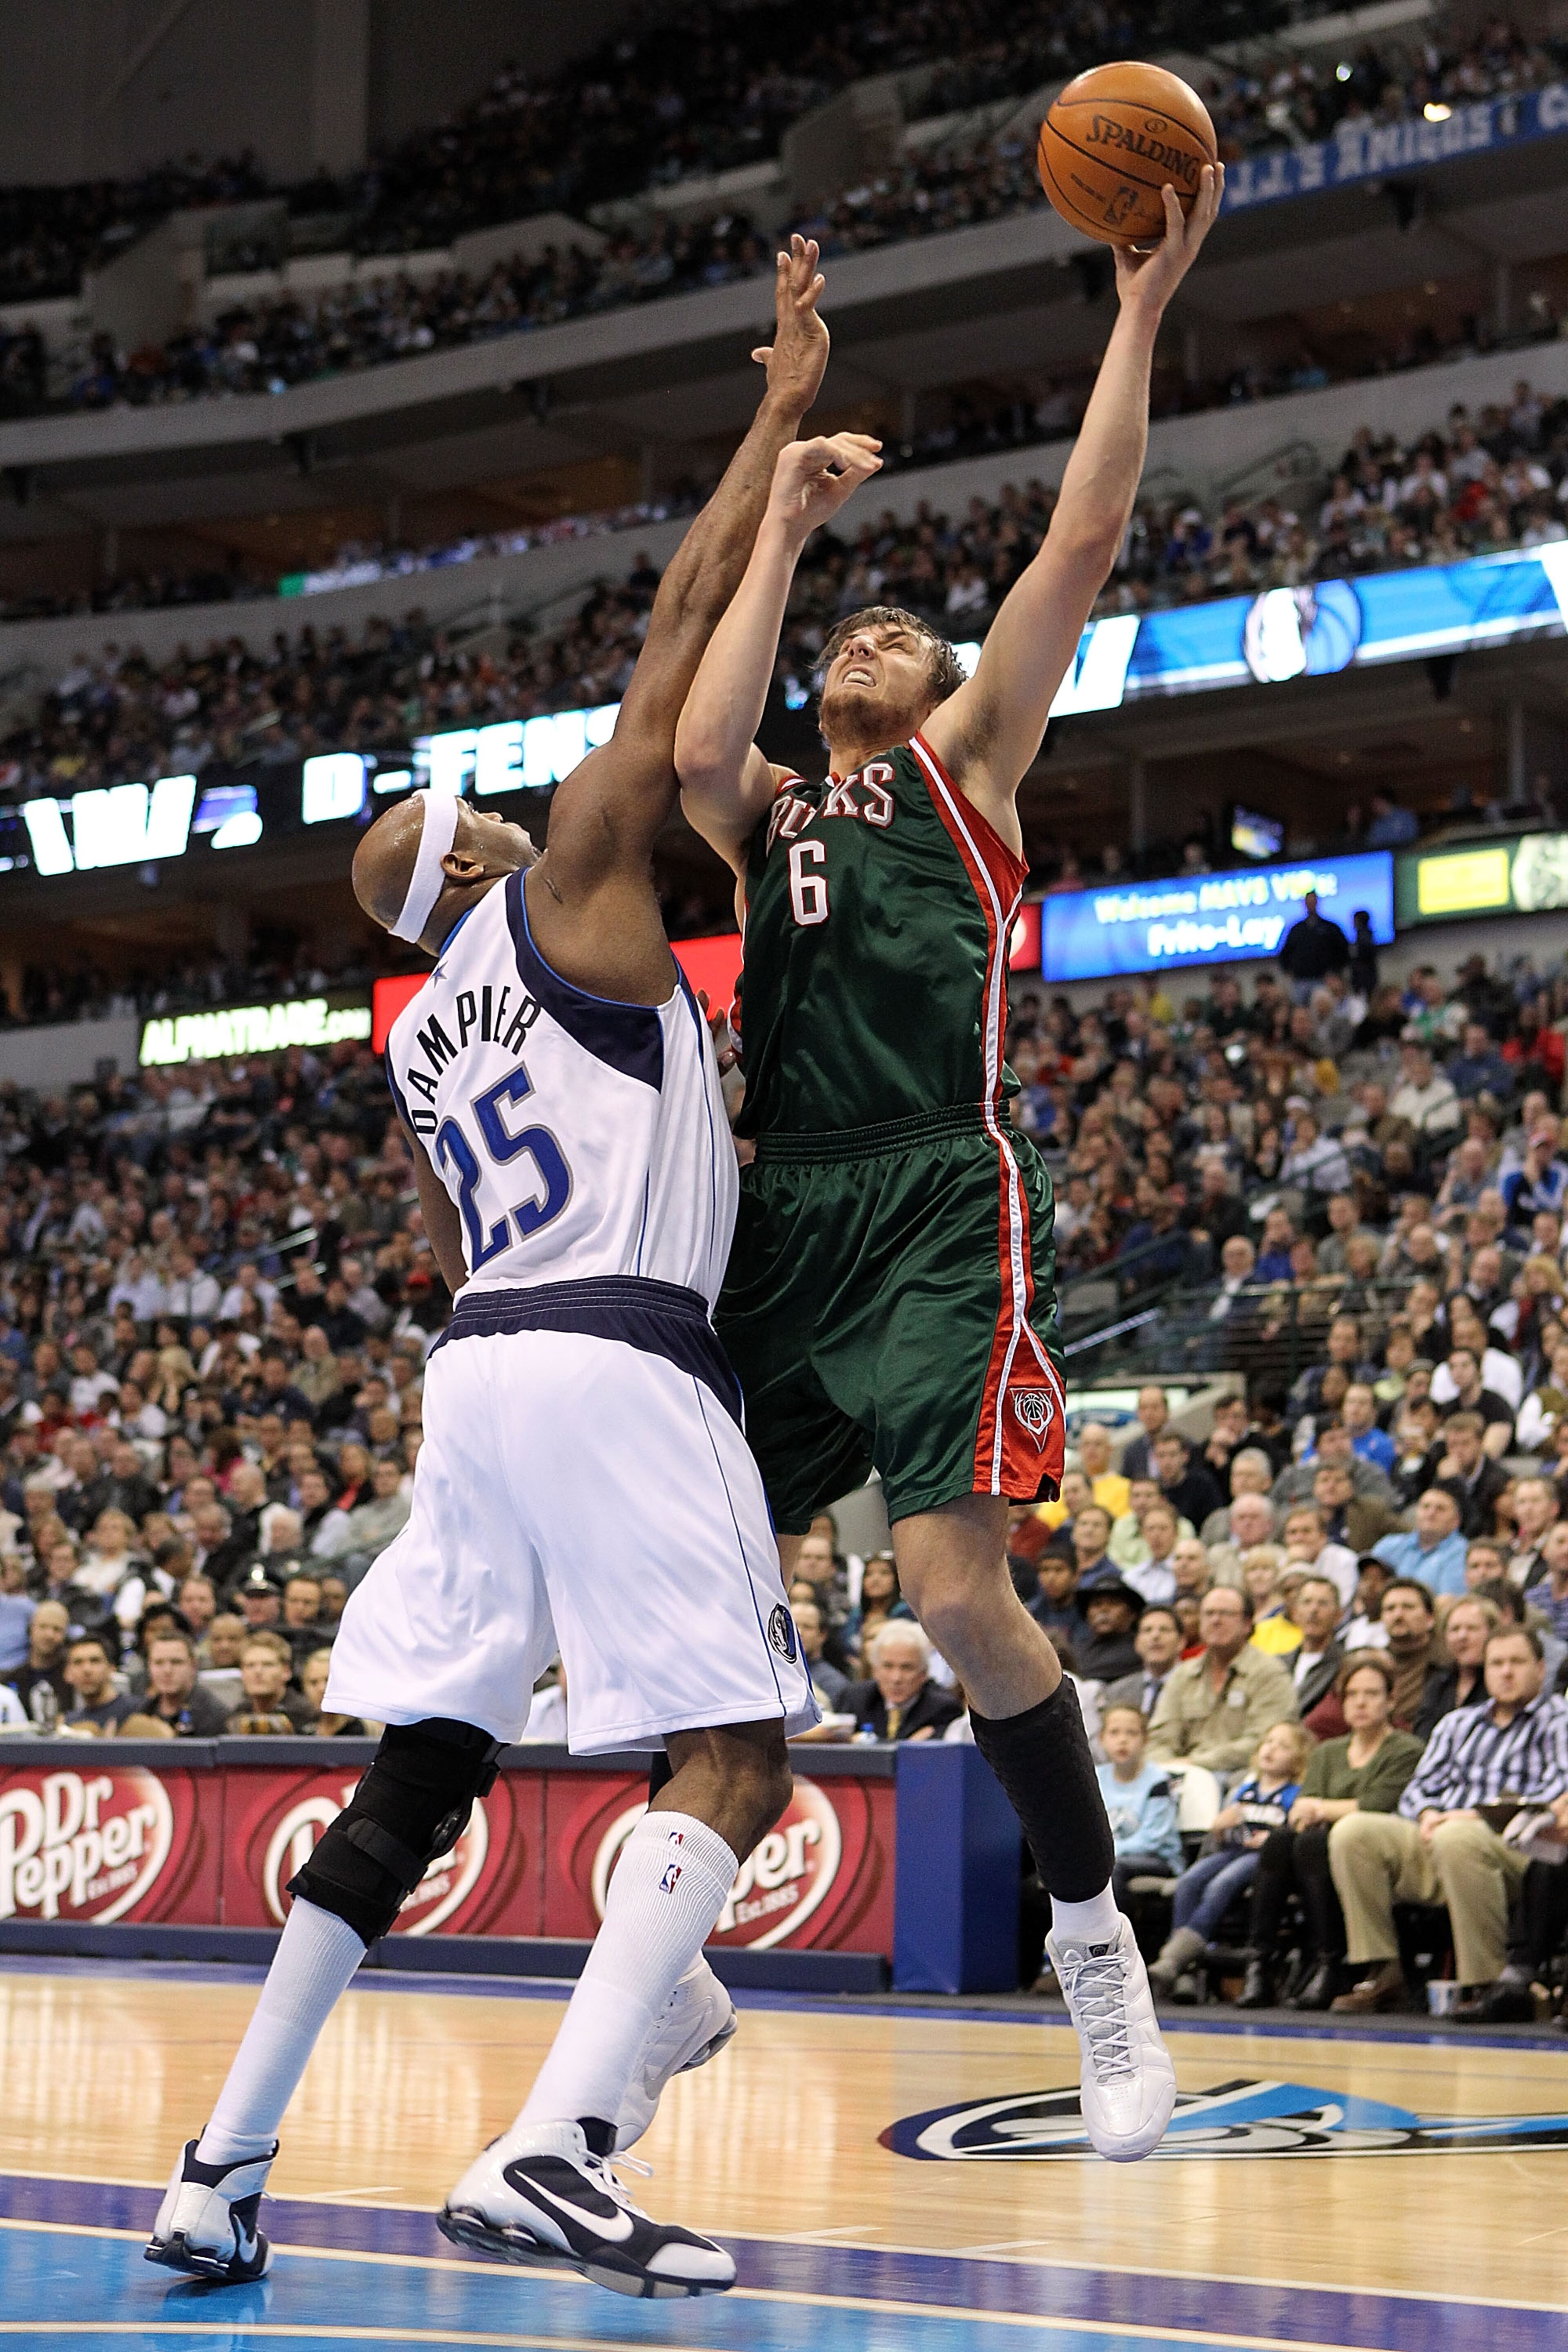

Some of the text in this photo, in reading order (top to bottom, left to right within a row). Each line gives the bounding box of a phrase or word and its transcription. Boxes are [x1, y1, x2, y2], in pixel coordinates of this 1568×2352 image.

[1086, 114, 1200, 185] SPALDING
[789, 838, 830, 927] 6
[1094, 892, 1197, 924] Welcome
[1199, 875, 1269, 911] MAVS
[1147, 914, 1285, 957] Frito-Lay
[408, 985, 541, 1134] DAMPIER
[434, 1060, 574, 1274] 25
[42, 1771, 114, 1849] Dr
[0, 1788, 157, 1920] Pepper
